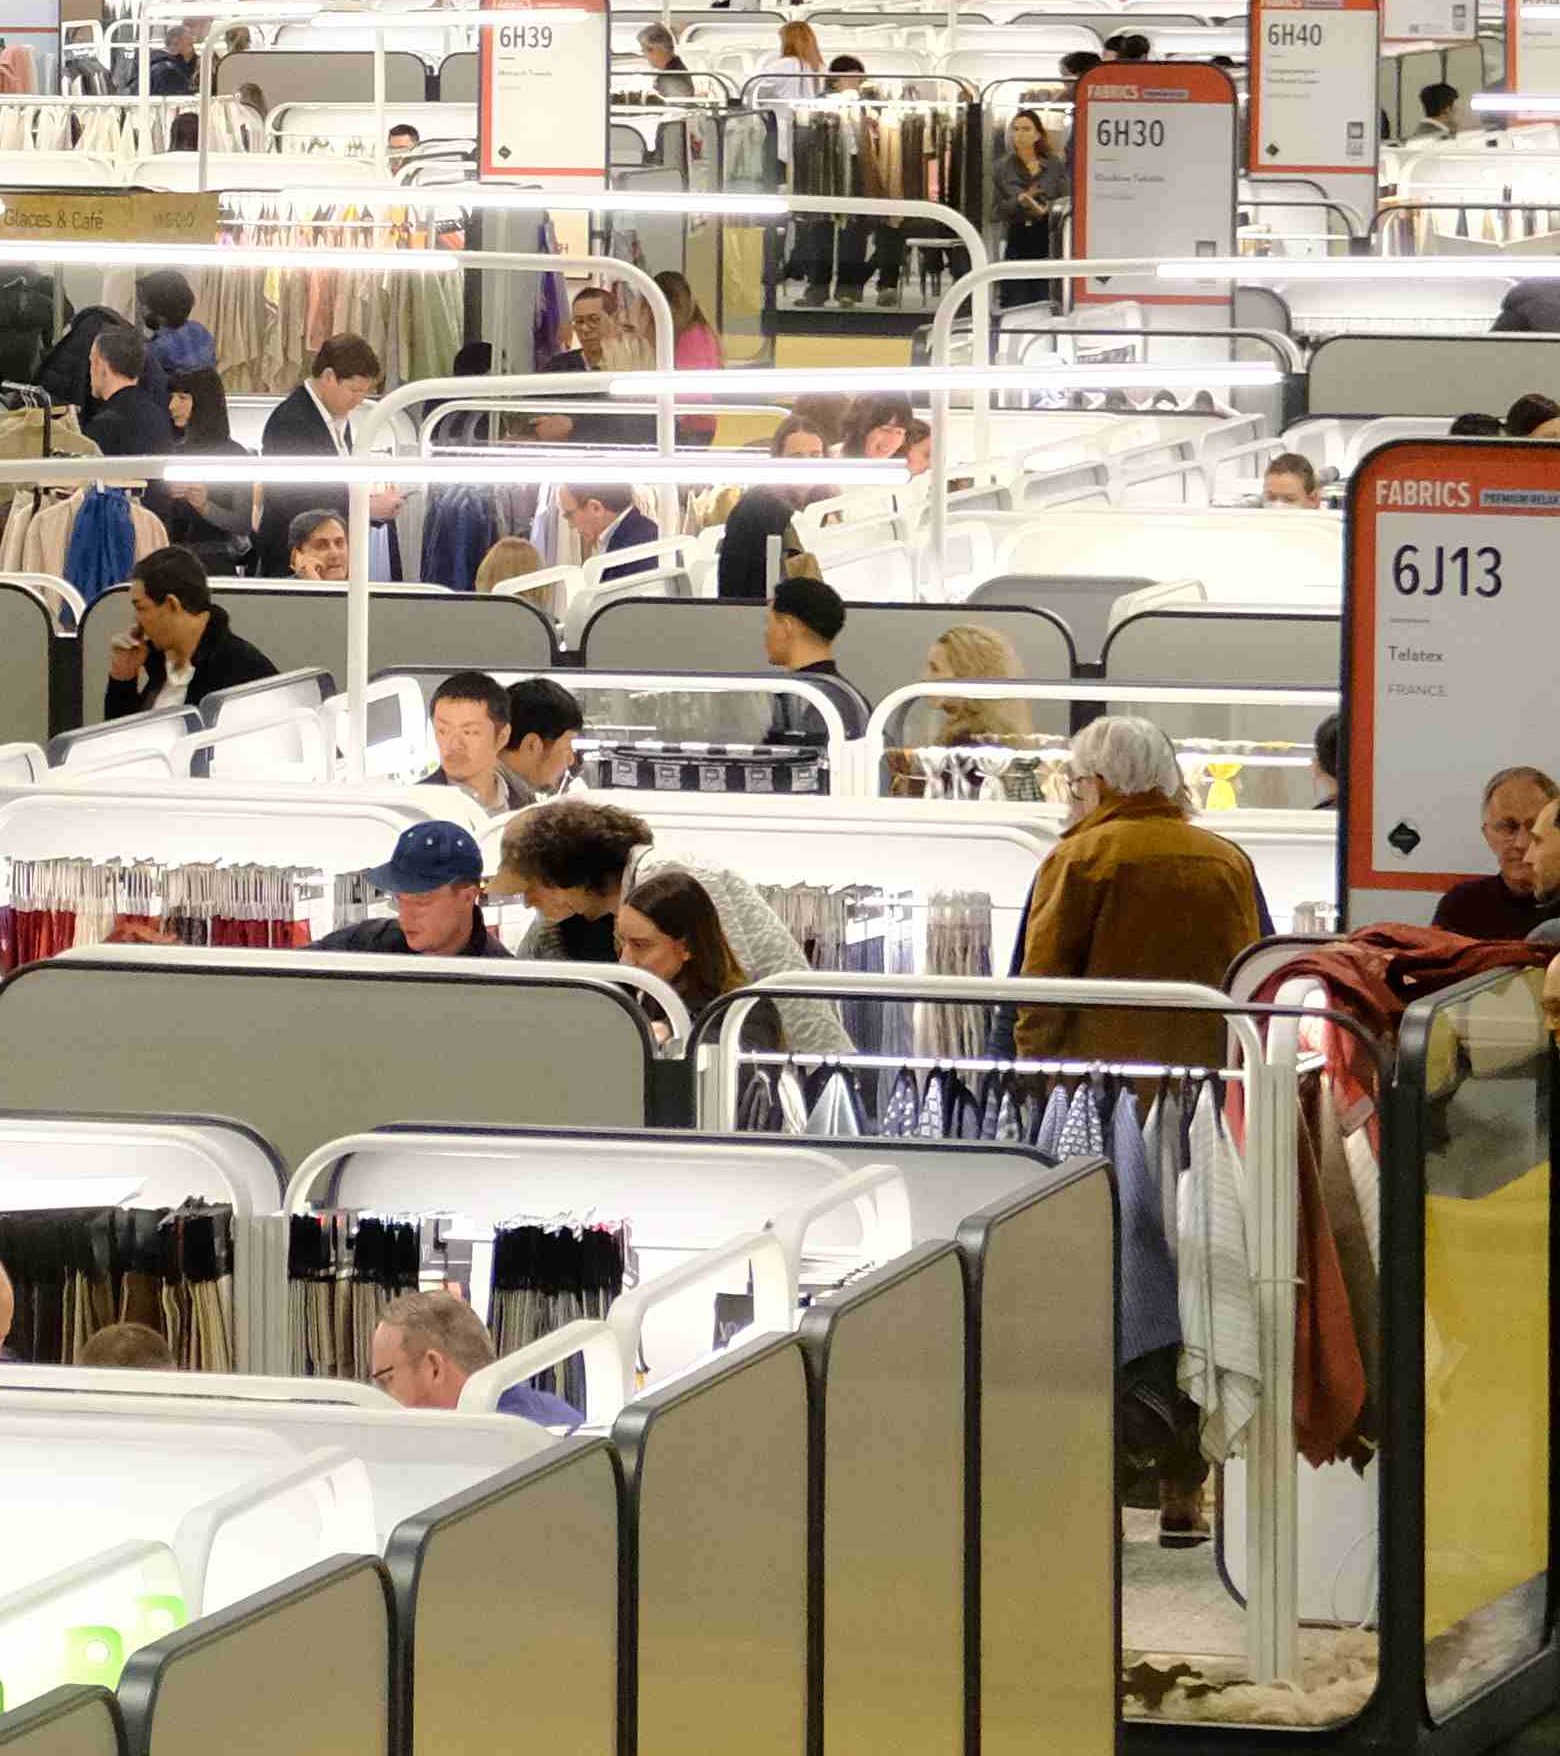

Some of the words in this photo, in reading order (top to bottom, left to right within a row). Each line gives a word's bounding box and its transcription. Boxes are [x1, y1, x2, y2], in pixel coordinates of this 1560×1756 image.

[499, 25, 553, 49] 6H39
[1267, 23, 1323, 47] 6H40
[1097, 119, 1165, 148] 6H30
[3, 208, 53, 228] Glaces
[57, 211, 67, 226] &
[72, 209, 104, 229] Café
[1375, 479, 1472, 508] FABRICS
[1483, 492, 1530, 505] PREMIUM
[1392, 543, 1503, 598] 6J13
[1387, 646, 1445, 663] Telatex
[1387, 683, 1449, 698] FRANCE
